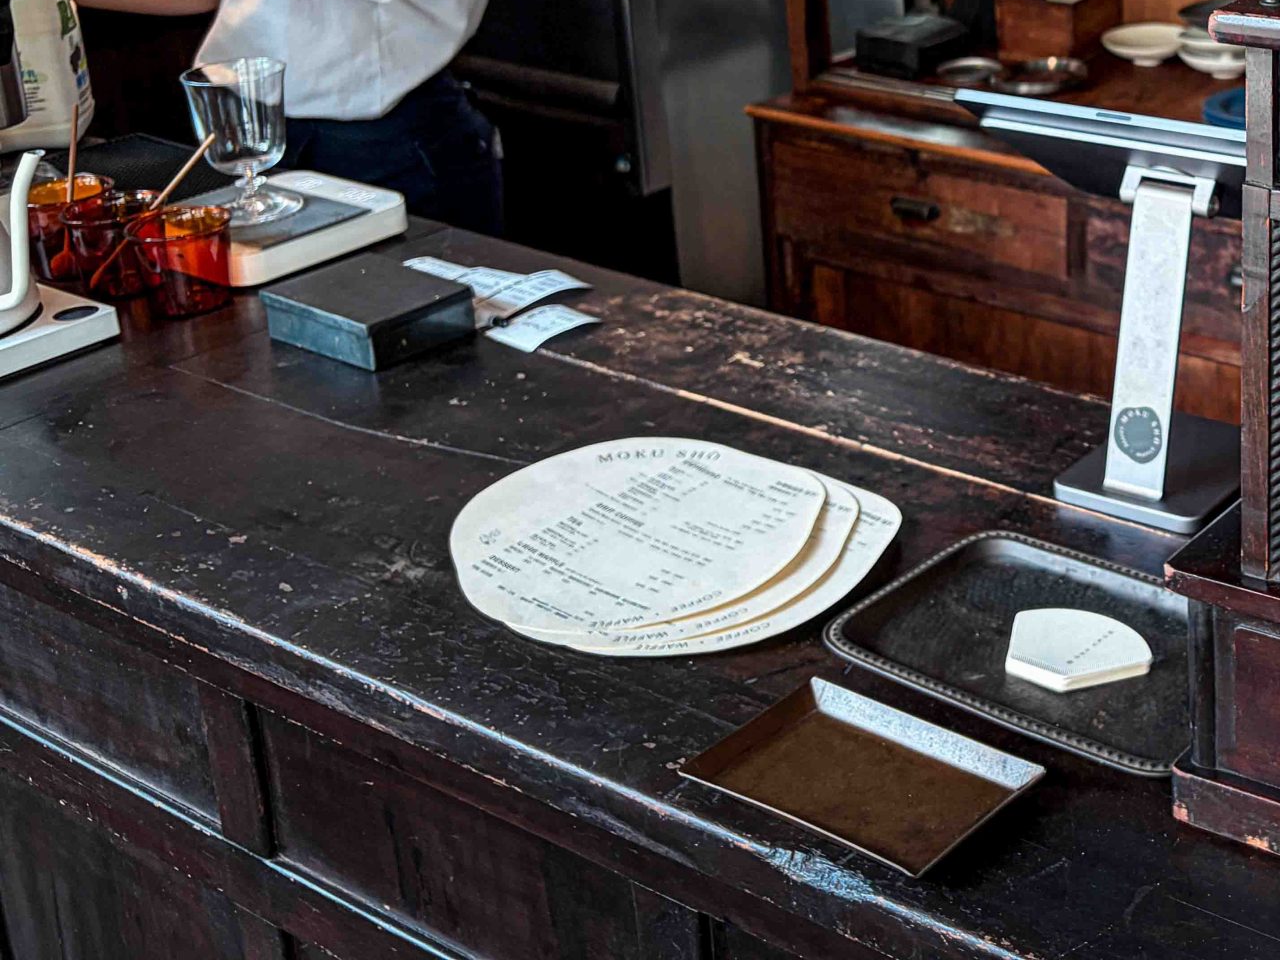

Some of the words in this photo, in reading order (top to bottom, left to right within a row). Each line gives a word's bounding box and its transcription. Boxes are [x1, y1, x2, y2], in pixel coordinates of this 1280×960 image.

[598, 448, 664, 463] MOKU
[489, 554, 521, 573] DESSERT
[671, 590, 722, 613] COFFEE
[695, 607, 748, 630] COFFEE
[716, 622, 770, 643] COFFEE
